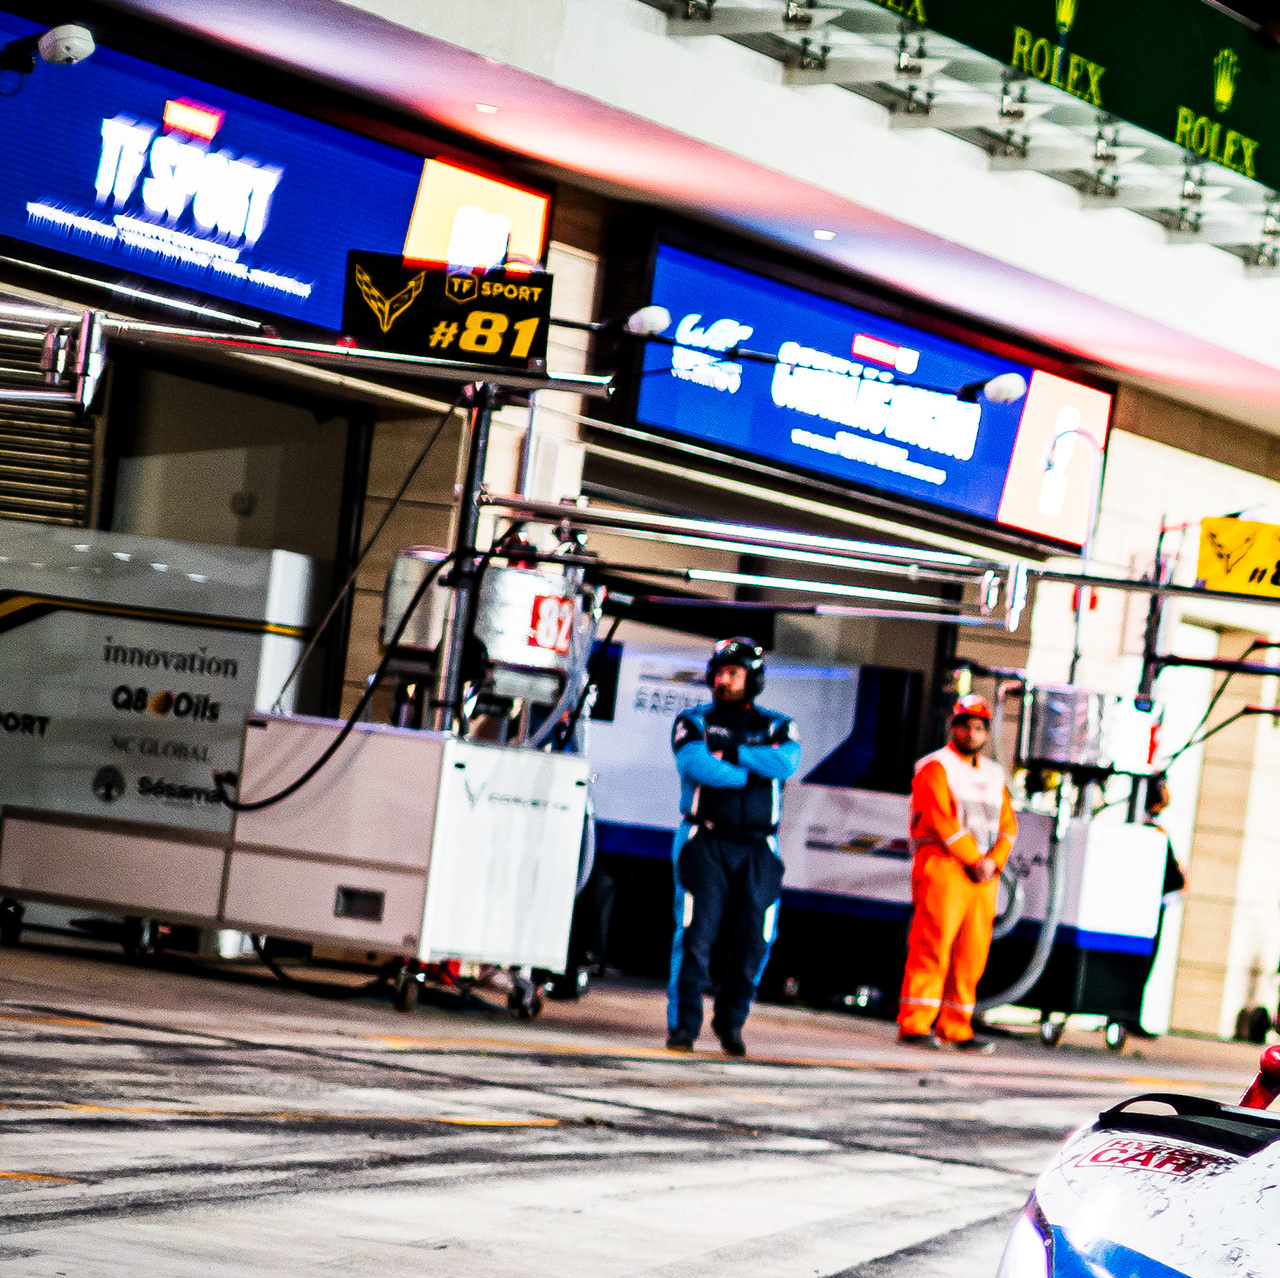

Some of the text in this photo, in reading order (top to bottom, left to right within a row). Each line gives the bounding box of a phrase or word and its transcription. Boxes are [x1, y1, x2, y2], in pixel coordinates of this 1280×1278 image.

[1011, 25, 1106, 106] ROLEX
[1175, 105, 1260, 178] ROLEX
[450, 277, 543, 302] TF SPORT
[428, 310, 540, 358] #81
[104, 635, 238, 678] innovation
[0, 711, 51, 738] ORT
[1090, 1148, 1197, 1173] CAR
